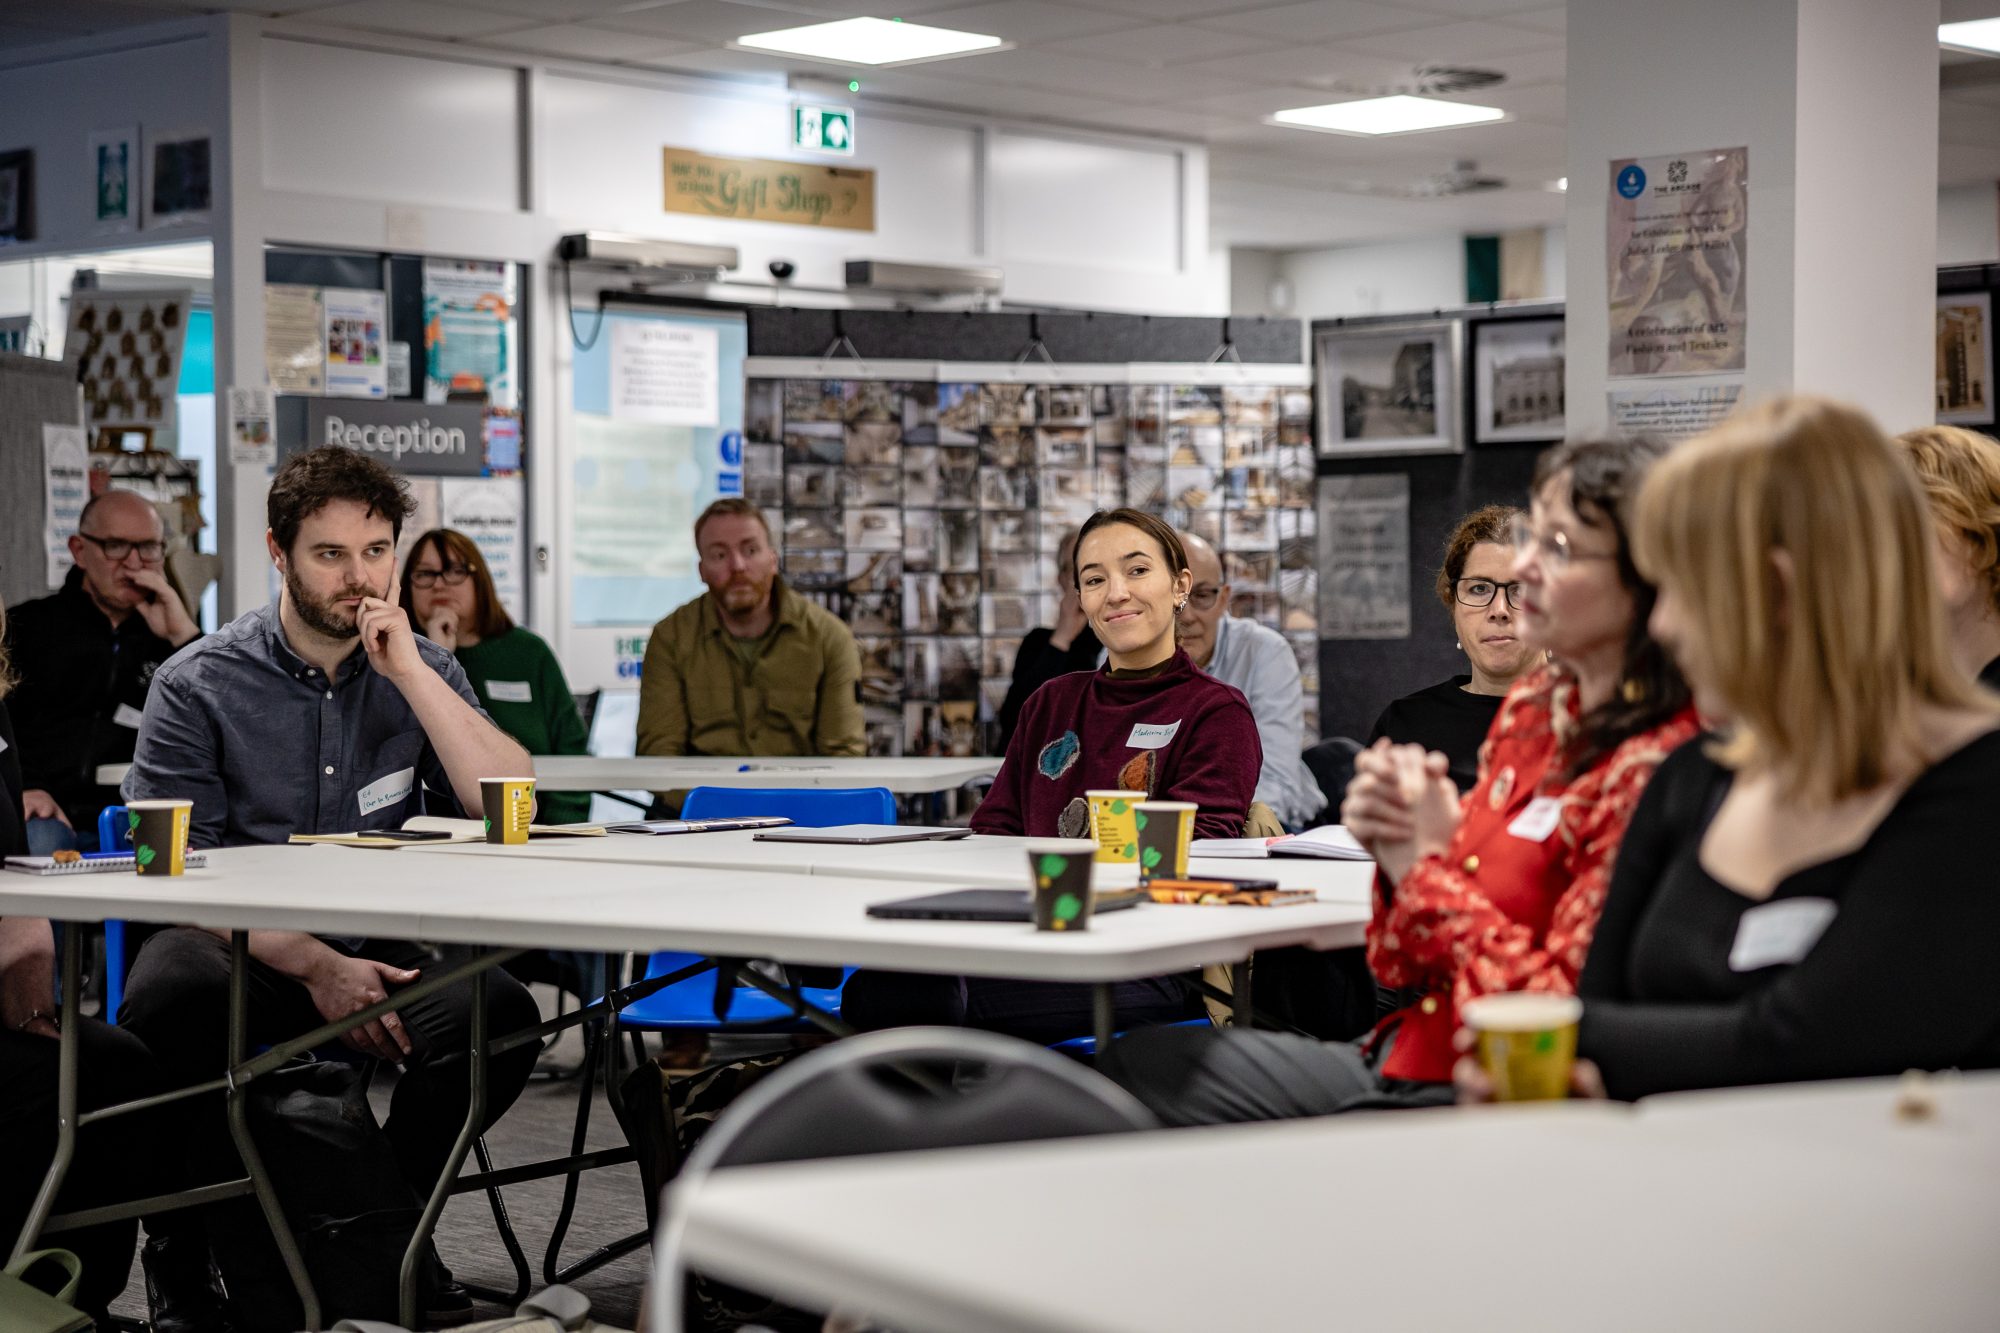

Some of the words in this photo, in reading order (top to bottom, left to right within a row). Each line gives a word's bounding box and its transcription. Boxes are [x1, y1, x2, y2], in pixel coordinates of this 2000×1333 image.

[1671, 183, 1701, 193] ARCADE
[704, 166, 768, 215] Gift
[776, 171, 832, 224] Shop
[1634, 324, 1692, 337] celebration
[1666, 341, 1686, 352] and
[1689, 339, 1728, 351] Textiles
[324, 415, 466, 460] Reception
